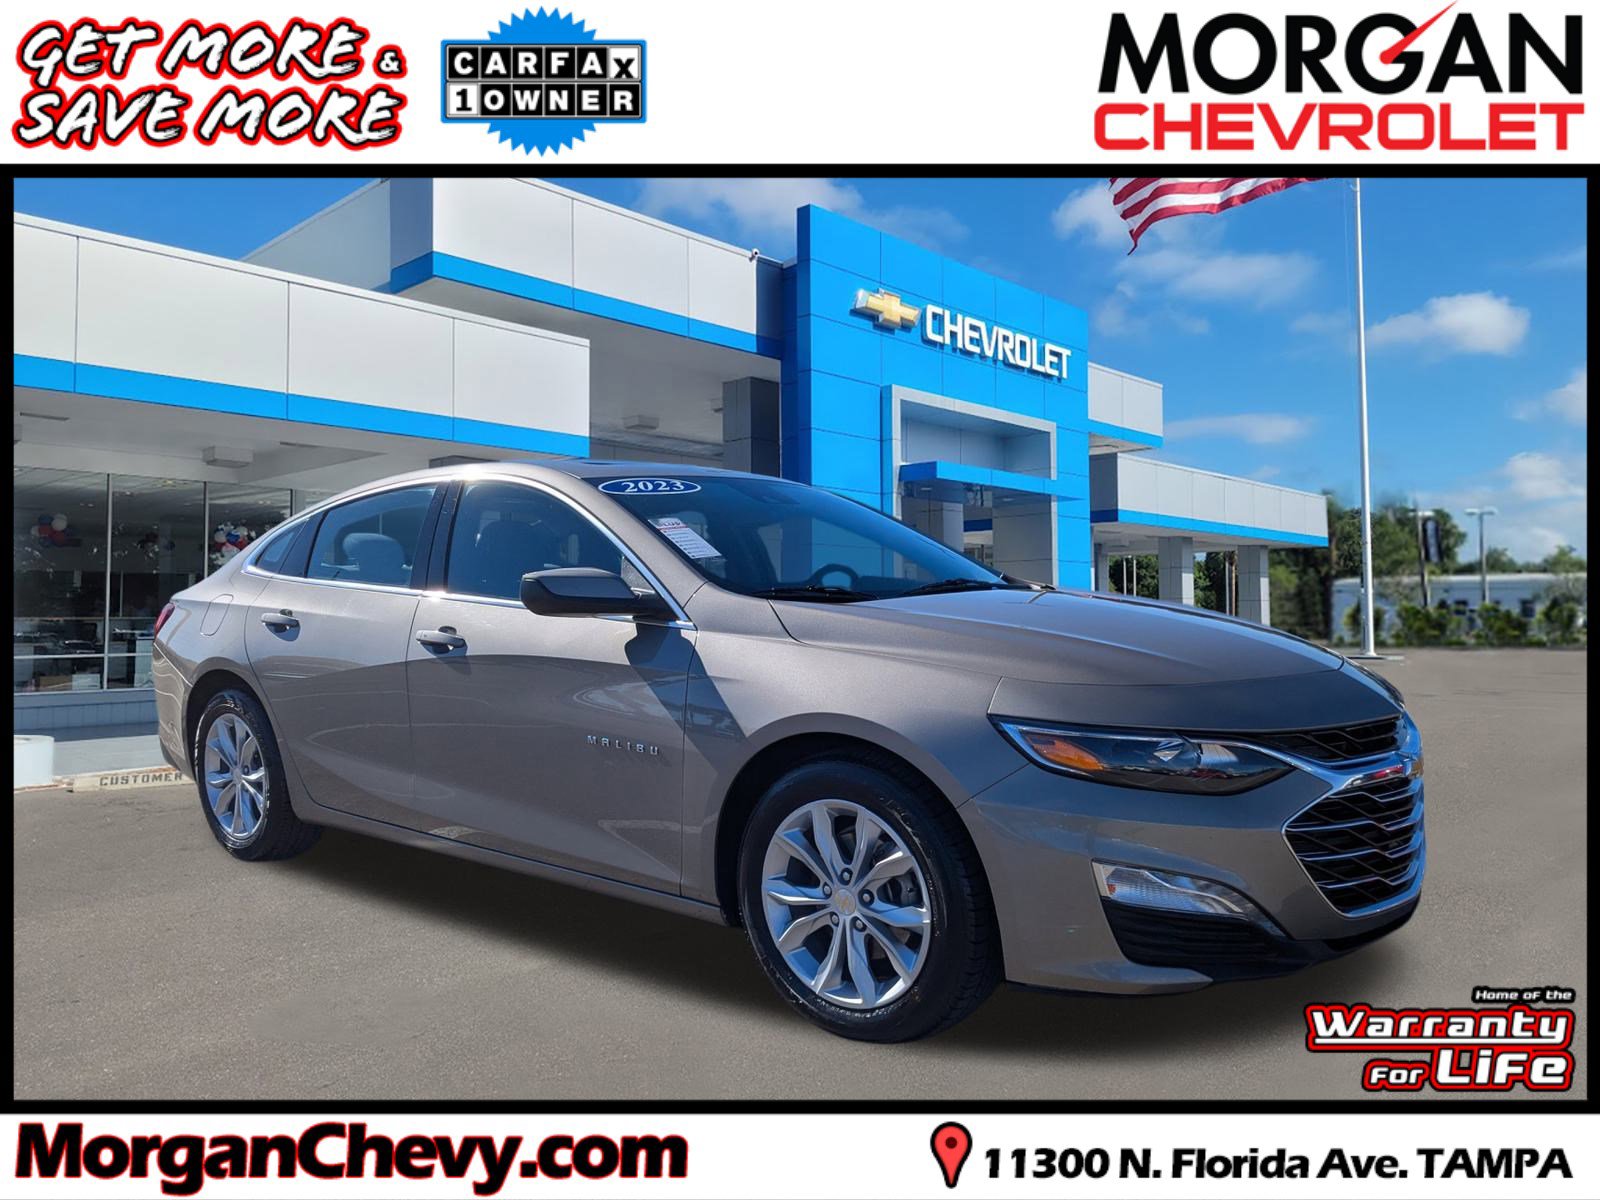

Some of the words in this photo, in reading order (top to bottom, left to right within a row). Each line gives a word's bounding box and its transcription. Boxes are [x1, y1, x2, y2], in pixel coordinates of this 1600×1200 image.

[923, 304, 1072, 379] CHEVROLET
[621, 480, 685, 493] 2023
[586, 735, 659, 756] MALIBU
[99, 771, 183, 787] CUSTOMER
